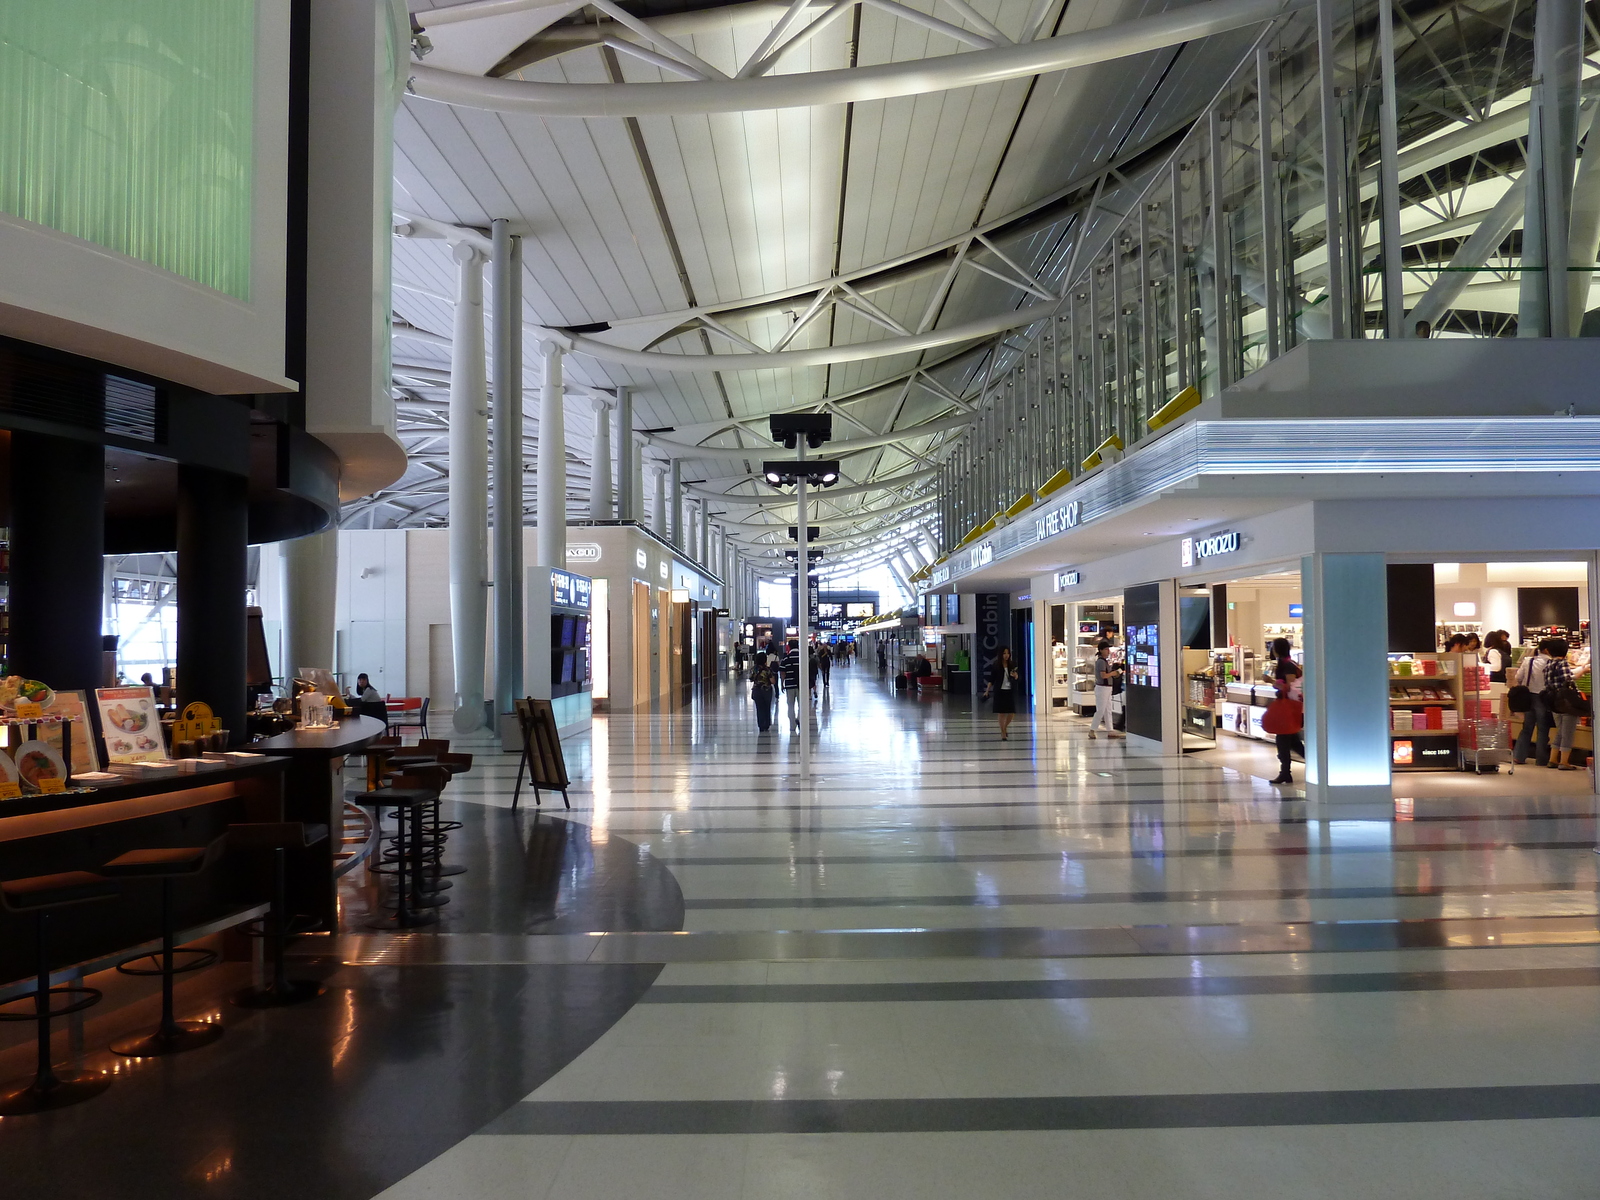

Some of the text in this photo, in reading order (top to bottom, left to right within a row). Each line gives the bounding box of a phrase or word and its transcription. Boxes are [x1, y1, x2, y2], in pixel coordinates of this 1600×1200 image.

[1036, 501, 1078, 541] TAX FREE SHOP
[1195, 532, 1238, 558] YOROZU
[982, 594, 999, 650] Cabin
[1422, 748, 1437, 756] since
